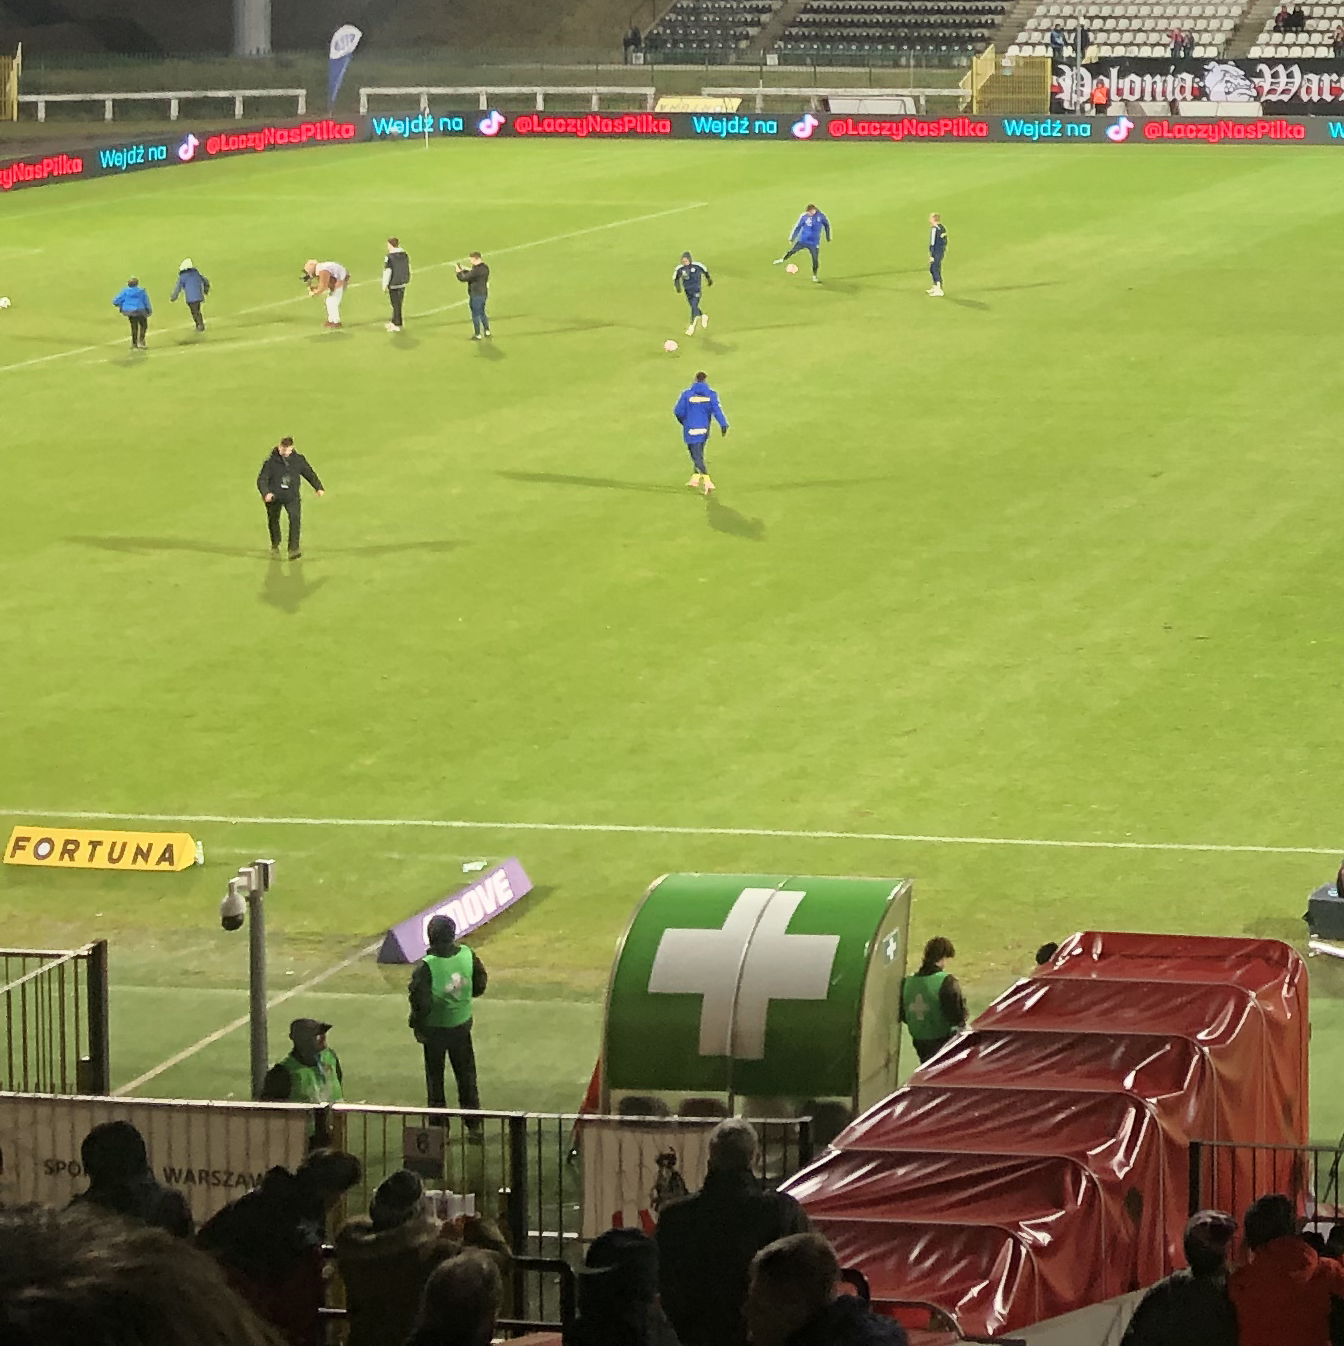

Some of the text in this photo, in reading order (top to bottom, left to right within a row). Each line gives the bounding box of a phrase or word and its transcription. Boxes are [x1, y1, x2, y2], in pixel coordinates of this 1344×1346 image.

[373, 116, 434, 137] Wejdź
[439, 118, 463, 131] na
[692, 115, 749, 138] Wejdź
[754, 120, 777, 133] na
[1003, 119, 1062, 141] Wejdź
[1066, 123, 1091, 136] na
[100, 145, 145, 170] Wejdź
[149, 145, 167, 161] na
[0, 154, 83, 189] zyNasPilka
[10, 836, 175, 867] FORTUNA
[163, 1165, 265, 1189] WARSZAW
